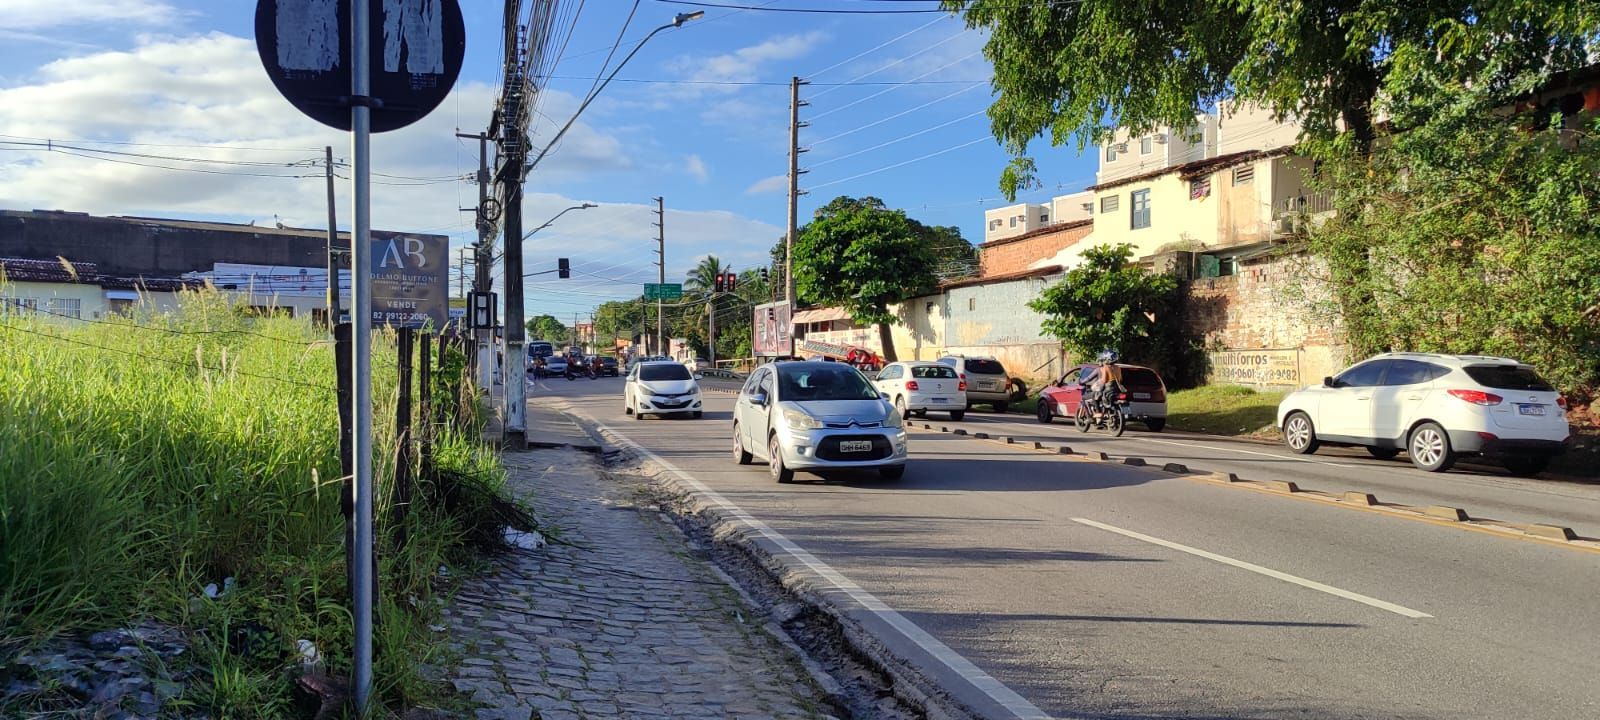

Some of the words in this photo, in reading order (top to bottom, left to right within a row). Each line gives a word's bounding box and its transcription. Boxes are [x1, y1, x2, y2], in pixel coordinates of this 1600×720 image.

[380, 238, 426, 269] AB
[370, 273, 400, 281] DELMO
[386, 300, 417, 309] VENDE
[373, 311, 382, 319] 82
[1214, 352, 1268, 365] multiforros
